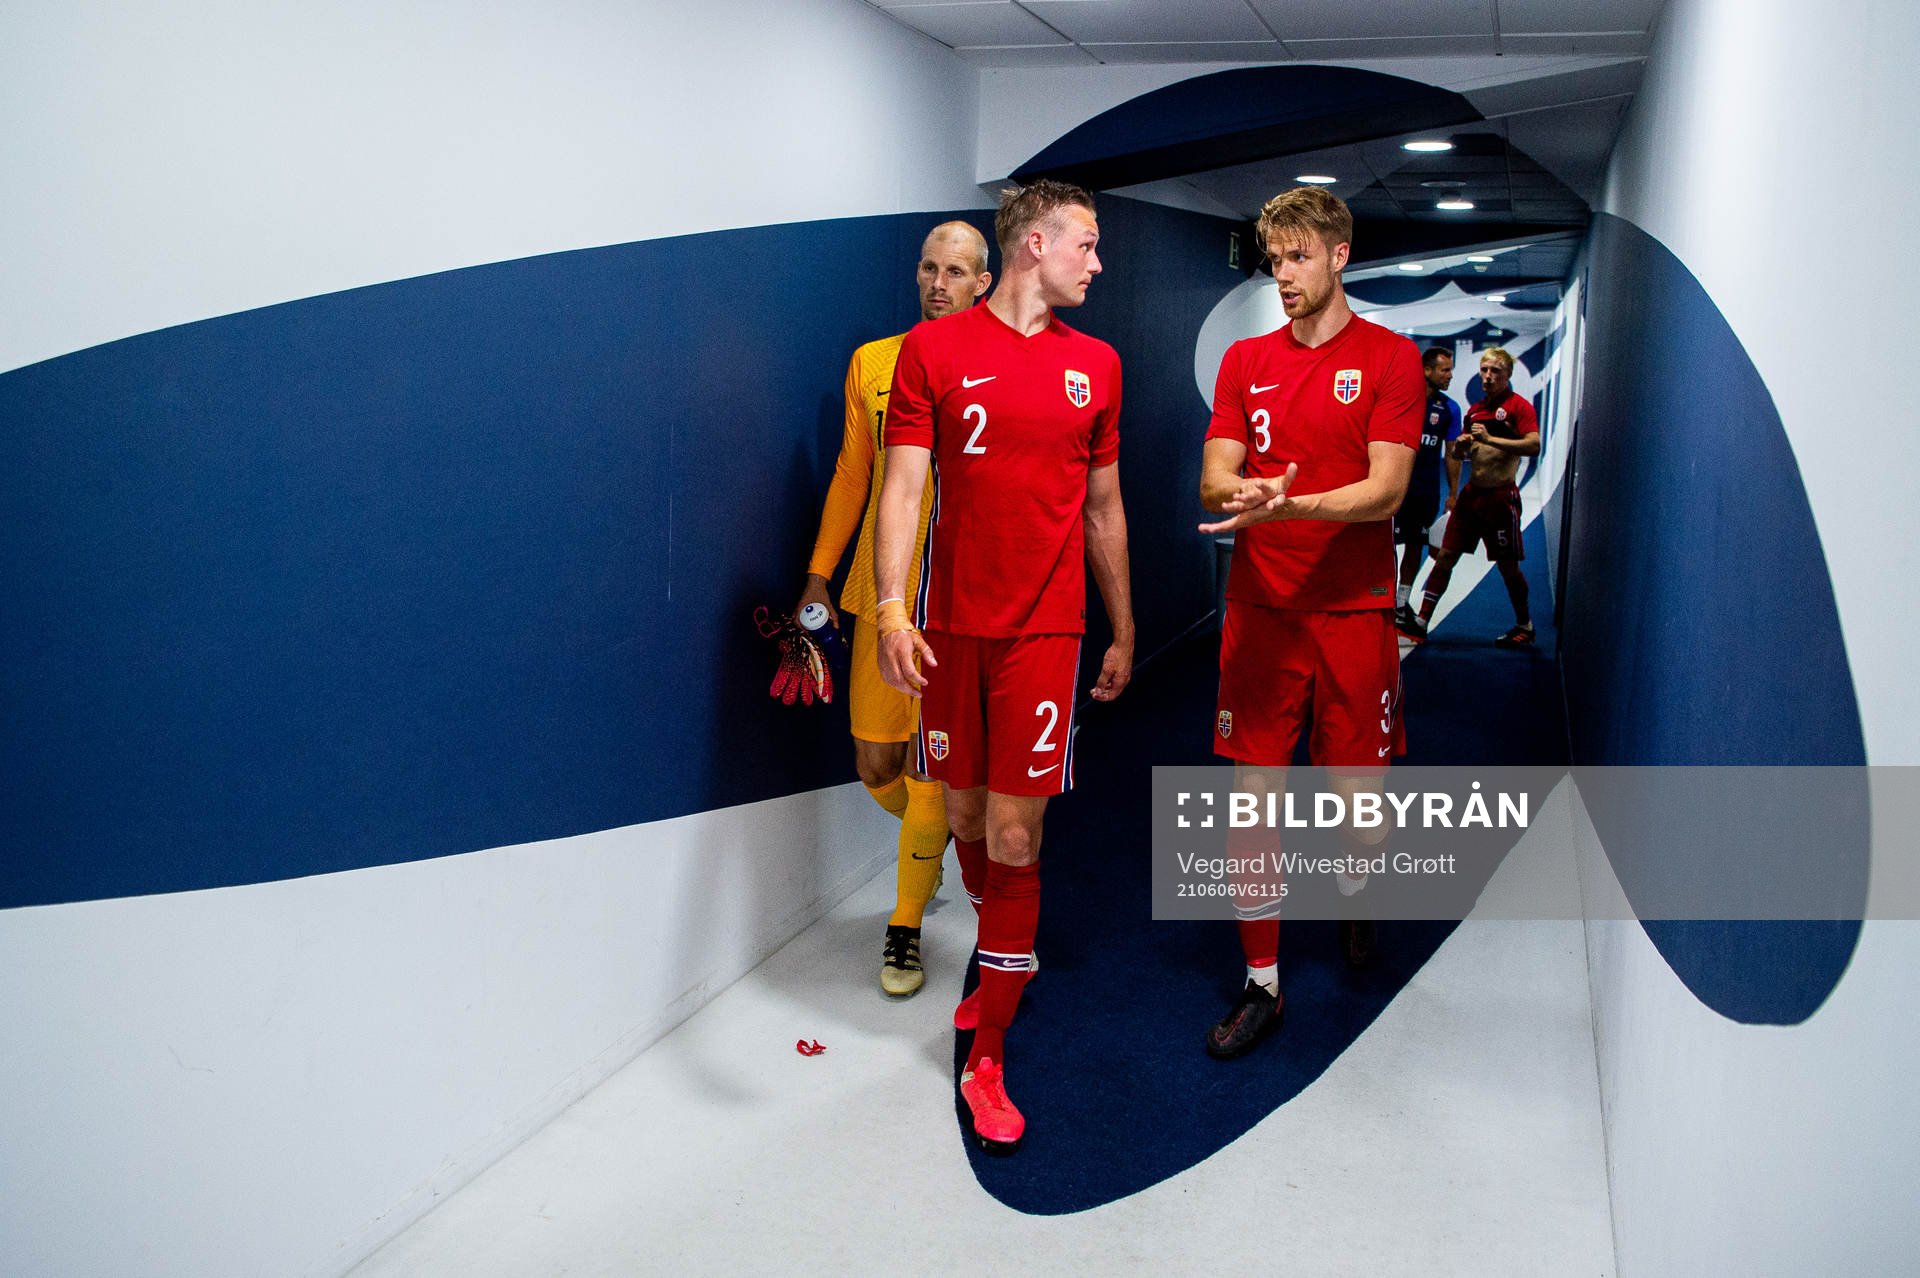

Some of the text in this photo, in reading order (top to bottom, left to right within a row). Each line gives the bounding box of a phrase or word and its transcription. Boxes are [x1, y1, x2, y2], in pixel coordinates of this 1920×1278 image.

[962, 403, 987, 455] 2
[1251, 408, 1272, 453] 3
[1497, 530, 1509, 547] 5
[1032, 700, 1059, 752] 2
[1380, 689, 1391, 734] 3
